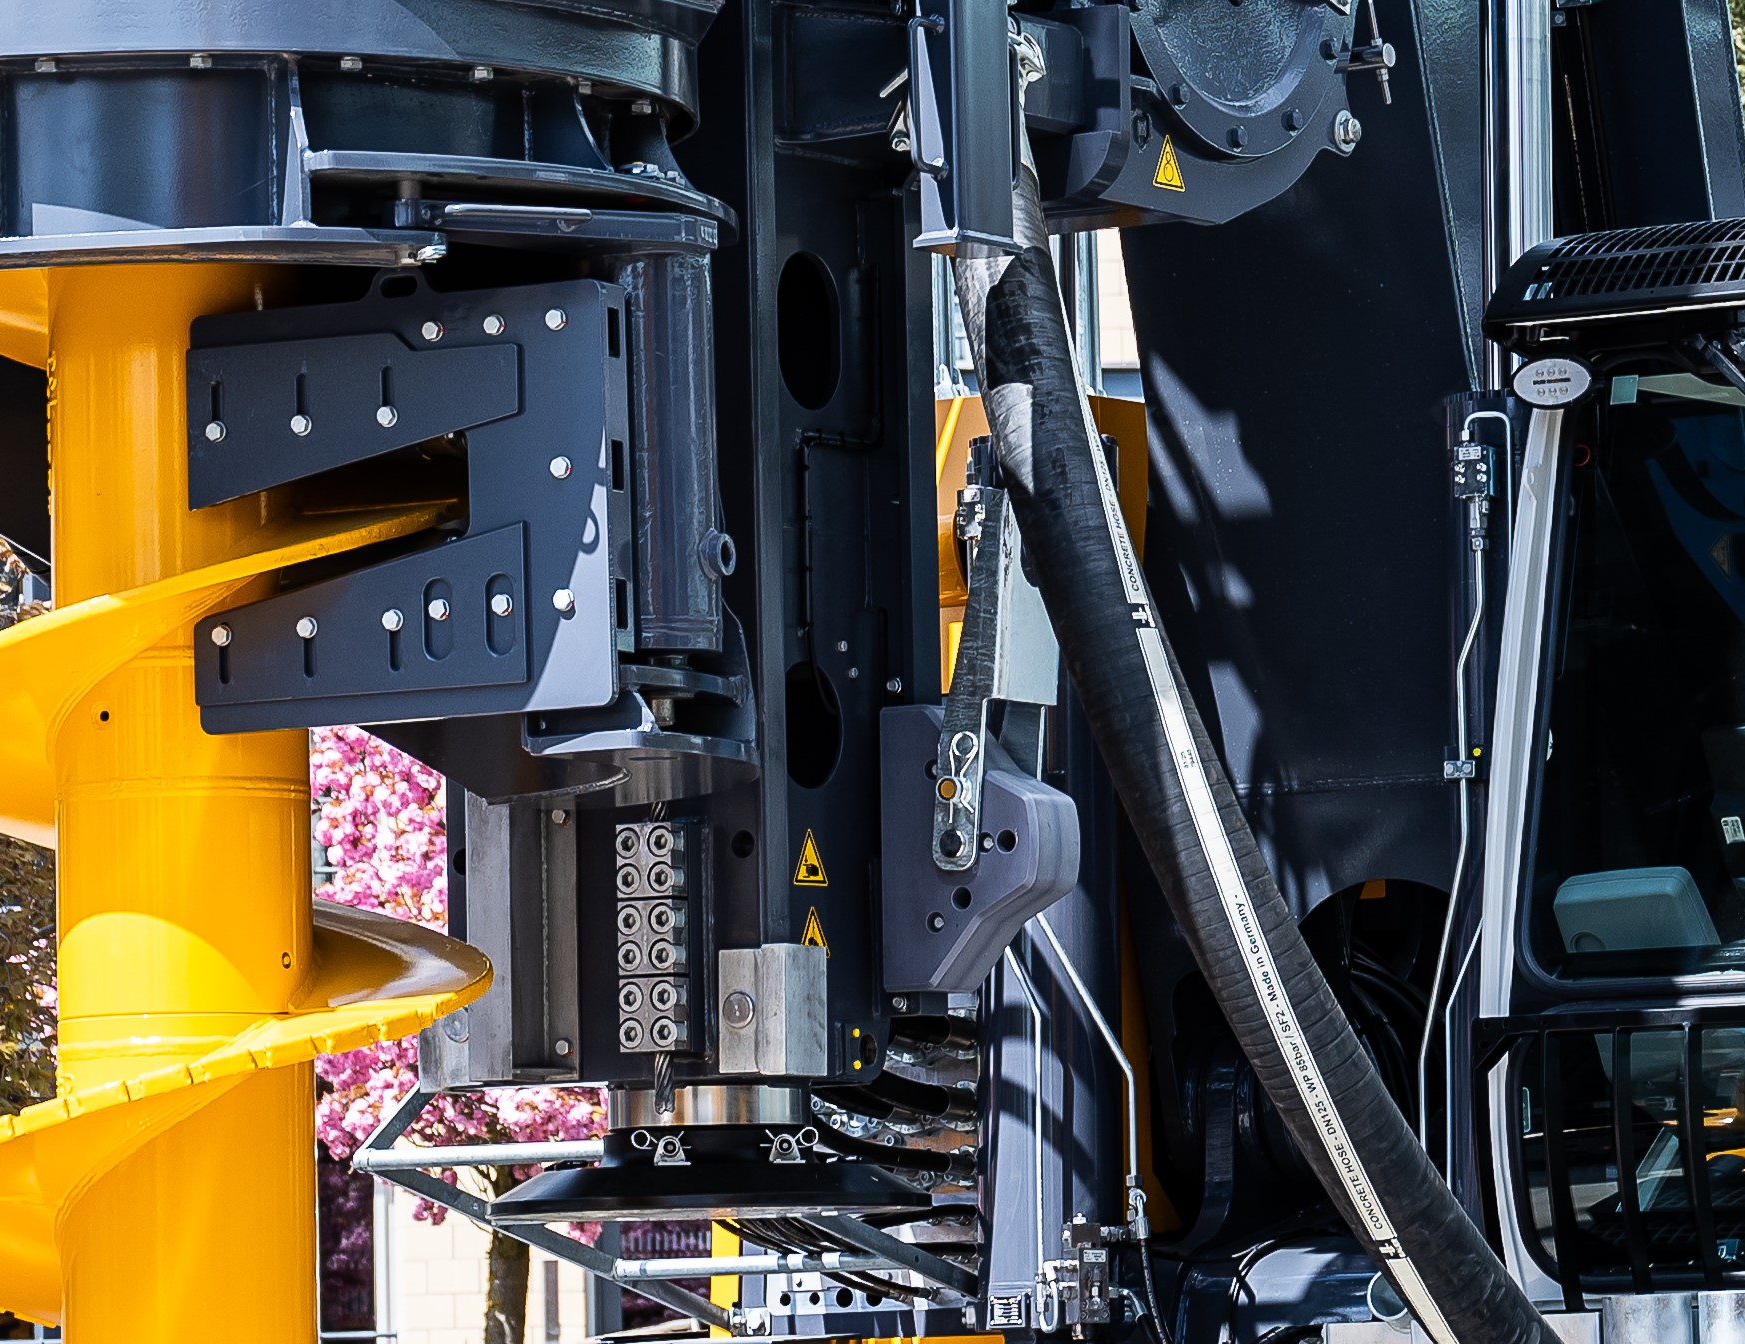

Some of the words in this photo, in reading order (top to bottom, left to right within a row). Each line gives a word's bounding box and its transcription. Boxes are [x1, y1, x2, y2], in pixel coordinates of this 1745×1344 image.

[1109, 500, 1124, 530] HOSE
[1117, 530, 1140, 592] CONCRETE
[1236, 902, 1260, 954] Germany
[1257, 956, 1266, 969] in
[1262, 971, 1278, 1002] Made
[1276, 1010, 1291, 1033] SF2
[1290, 1042, 1308, 1072] 85bar
[1303, 1075, 1317, 1094] WP
[1315, 1100, 1336, 1136] DN125
[1334, 1142, 1354, 1174] HOSE
[1349, 1174, 1383, 1230] CONCRETE
